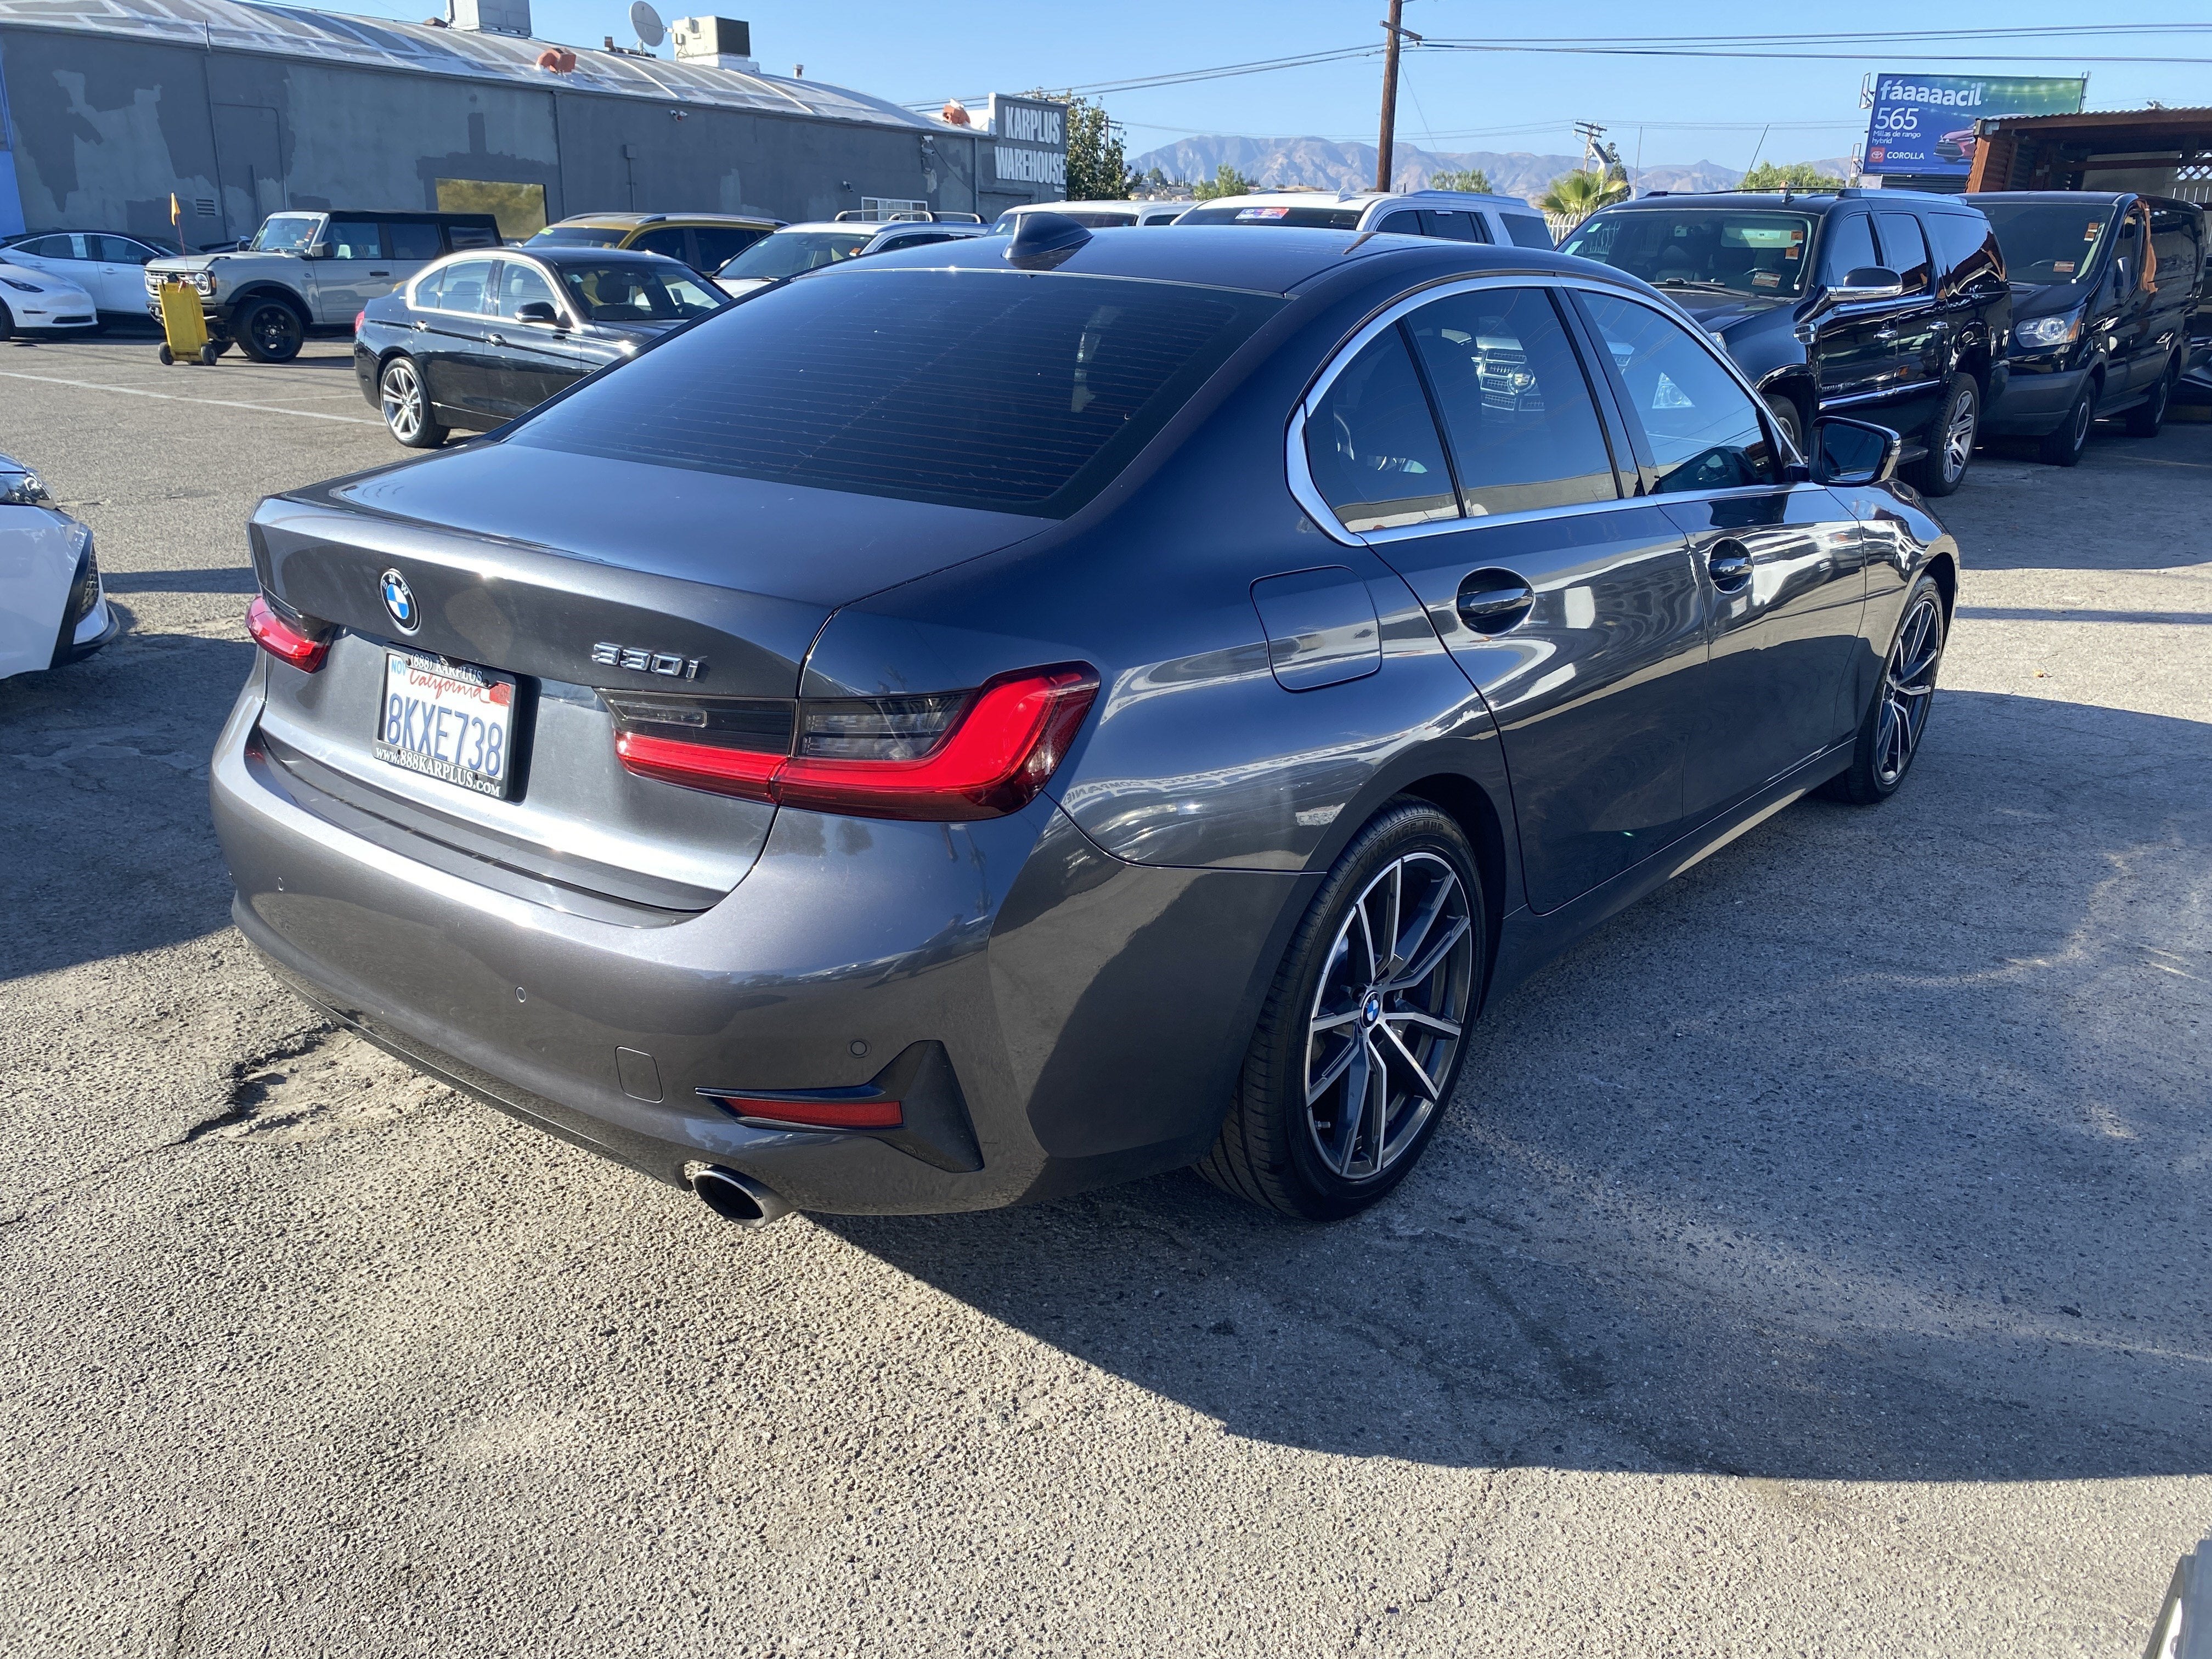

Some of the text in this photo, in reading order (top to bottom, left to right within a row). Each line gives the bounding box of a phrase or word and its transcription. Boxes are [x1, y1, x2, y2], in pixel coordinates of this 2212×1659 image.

[1880, 80, 1983, 106] fáaaaacil
[1005, 105, 1060, 144] KARPLUS
[1874, 107, 1919, 130] 565
[1901, 132, 1921, 140] rango
[994, 146, 1066, 185] WAREHOUSE
[1886, 151, 1925, 160] COROLLA
[382, 574, 409, 595] BMW
[411, 653, 483, 684] (888) KARPLUS
[591, 643, 699, 679] 330i
[410, 669, 491, 704] California
[387, 692, 503, 776] 8KXE738
